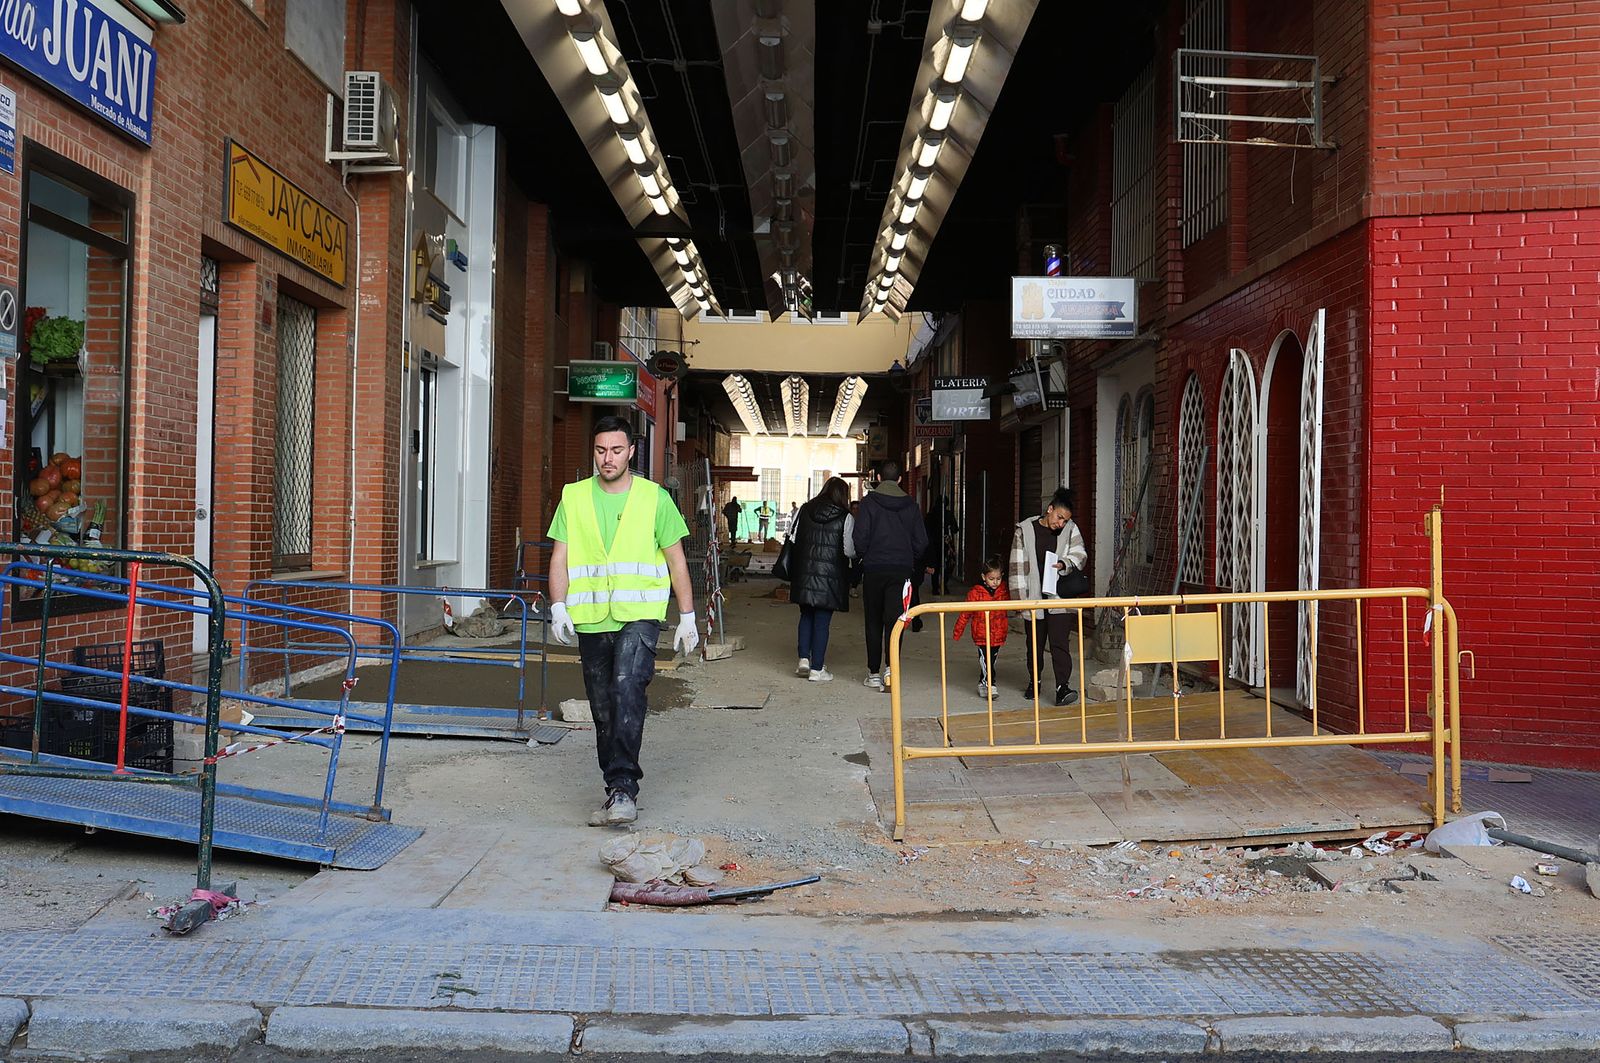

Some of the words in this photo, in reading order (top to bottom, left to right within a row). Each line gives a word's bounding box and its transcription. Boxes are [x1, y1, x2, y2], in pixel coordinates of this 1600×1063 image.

[43, 0, 152, 122] JUANI
[91, 94, 117, 121] Mercado
[117, 112, 125, 127] de
[125, 118, 147, 140] Abastos
[268, 175, 344, 262] JAYCASA
[286, 236, 333, 275] INMOBILIARIA
[1047, 287, 1096, 299] CIUDAD
[934, 378, 987, 388] PLATERIA
[916, 425, 952, 436] CONGELADOS
